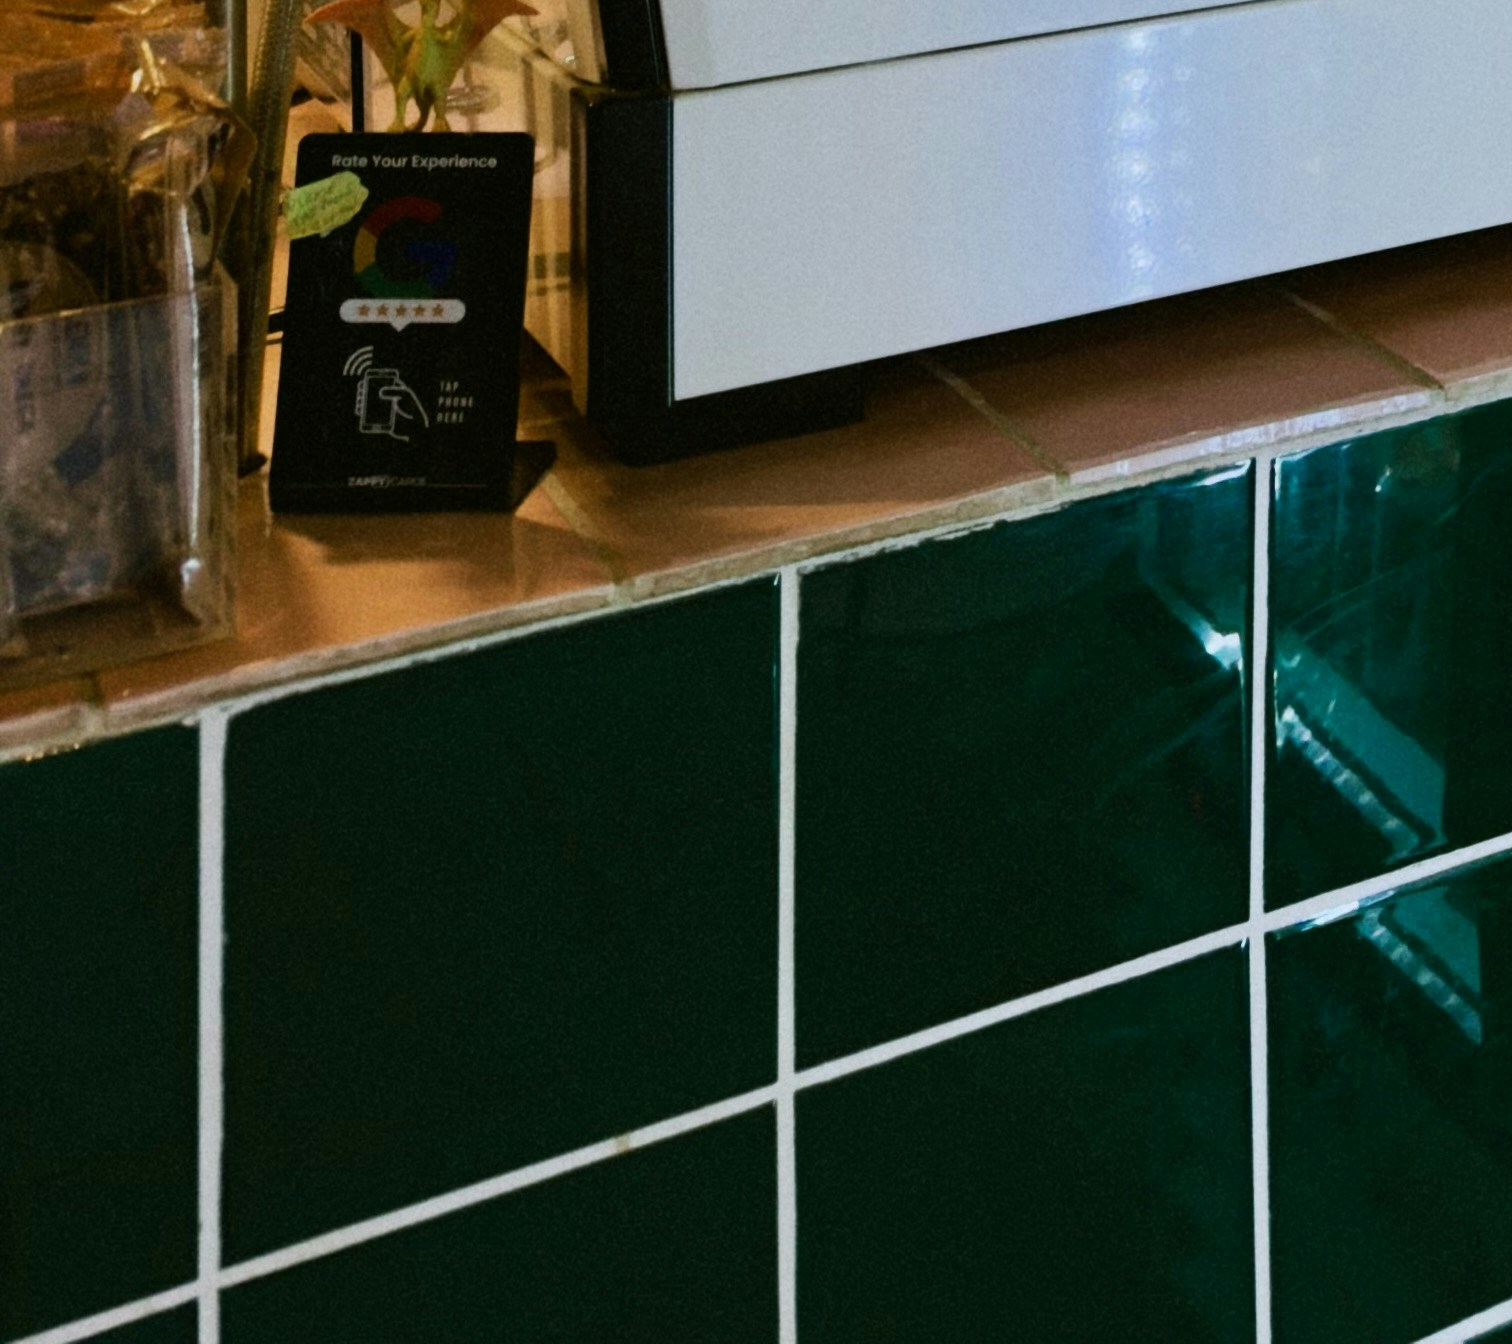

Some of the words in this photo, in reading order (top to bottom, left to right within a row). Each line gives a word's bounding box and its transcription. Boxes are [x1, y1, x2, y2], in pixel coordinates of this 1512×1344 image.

[332, 154, 368, 168] Rate
[372, 155, 408, 168] Your
[411, 154, 498, 171] Experience
[440, 381, 459, 393] TAP
[438, 396, 474, 408] PHONE
